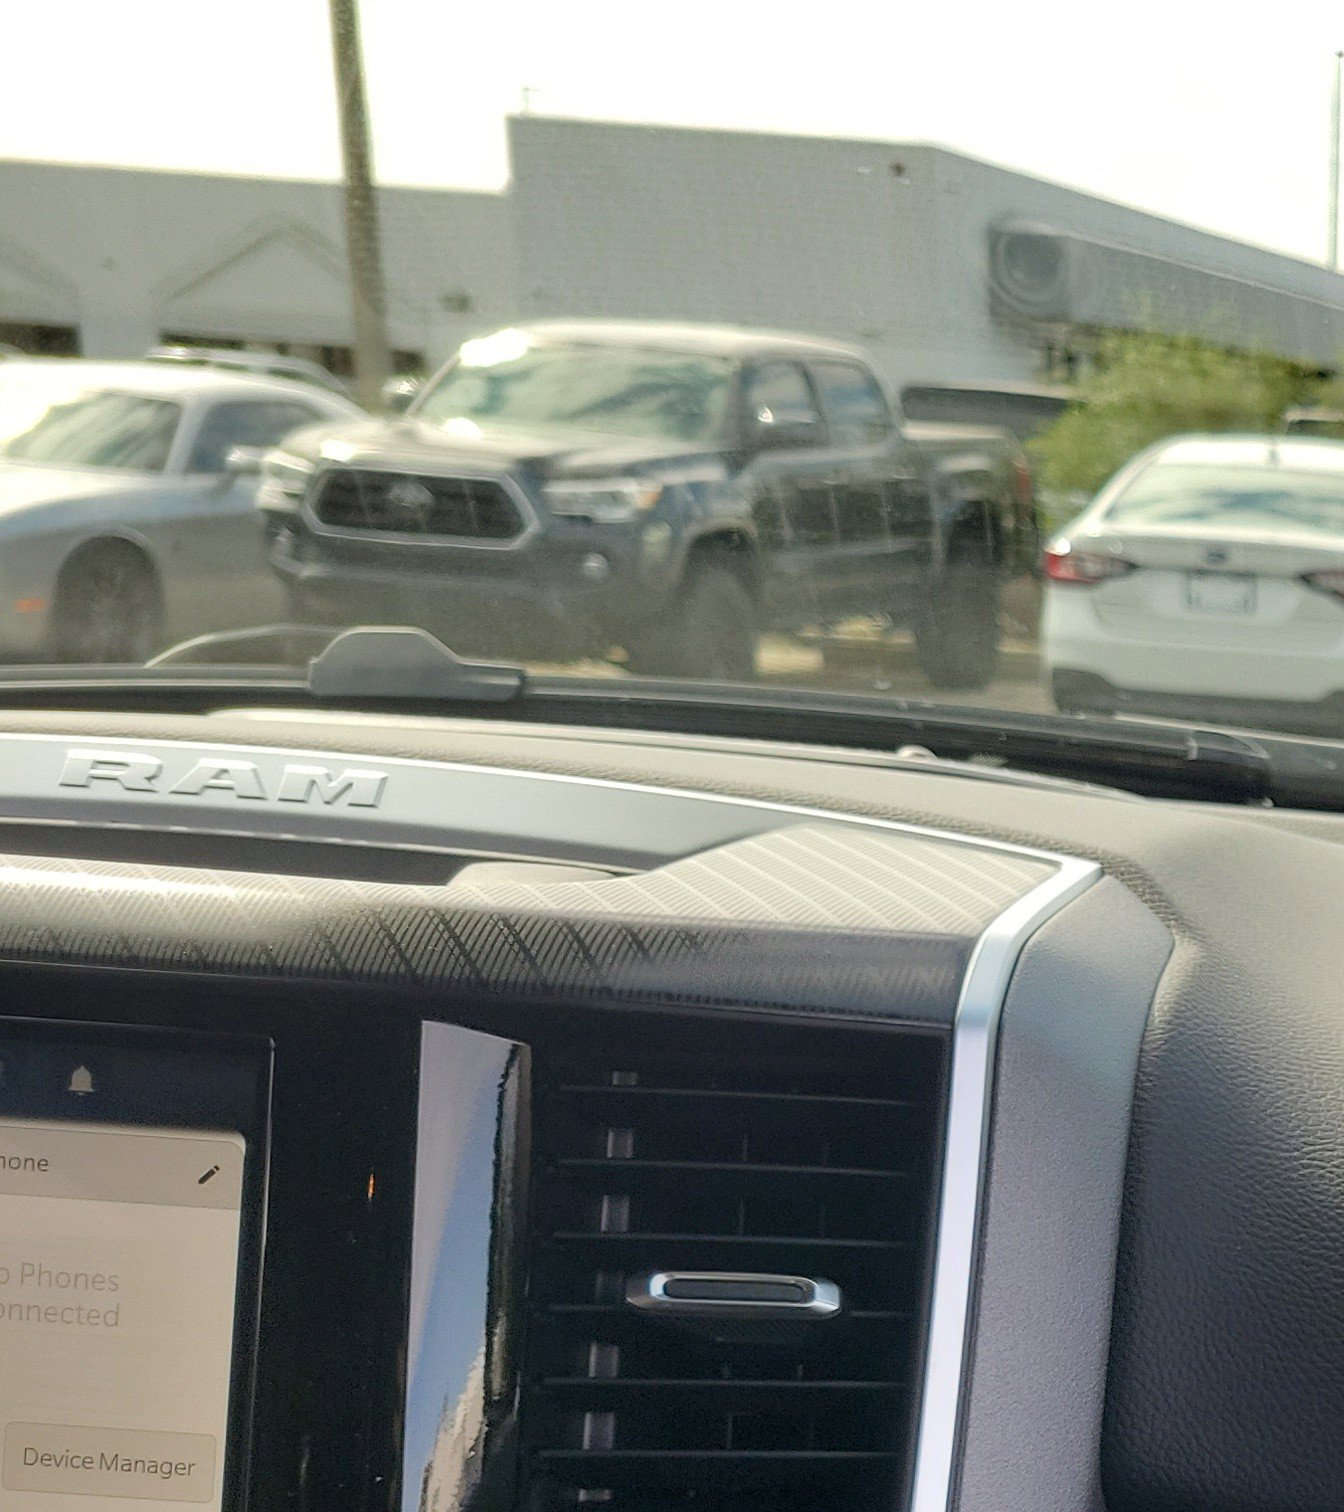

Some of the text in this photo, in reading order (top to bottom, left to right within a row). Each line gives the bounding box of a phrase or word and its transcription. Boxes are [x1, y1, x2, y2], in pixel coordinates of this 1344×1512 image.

[58, 748, 389, 809] RAM
[20, 1262, 120, 1292] Phones
[23, 1447, 196, 1480] Device Manager
